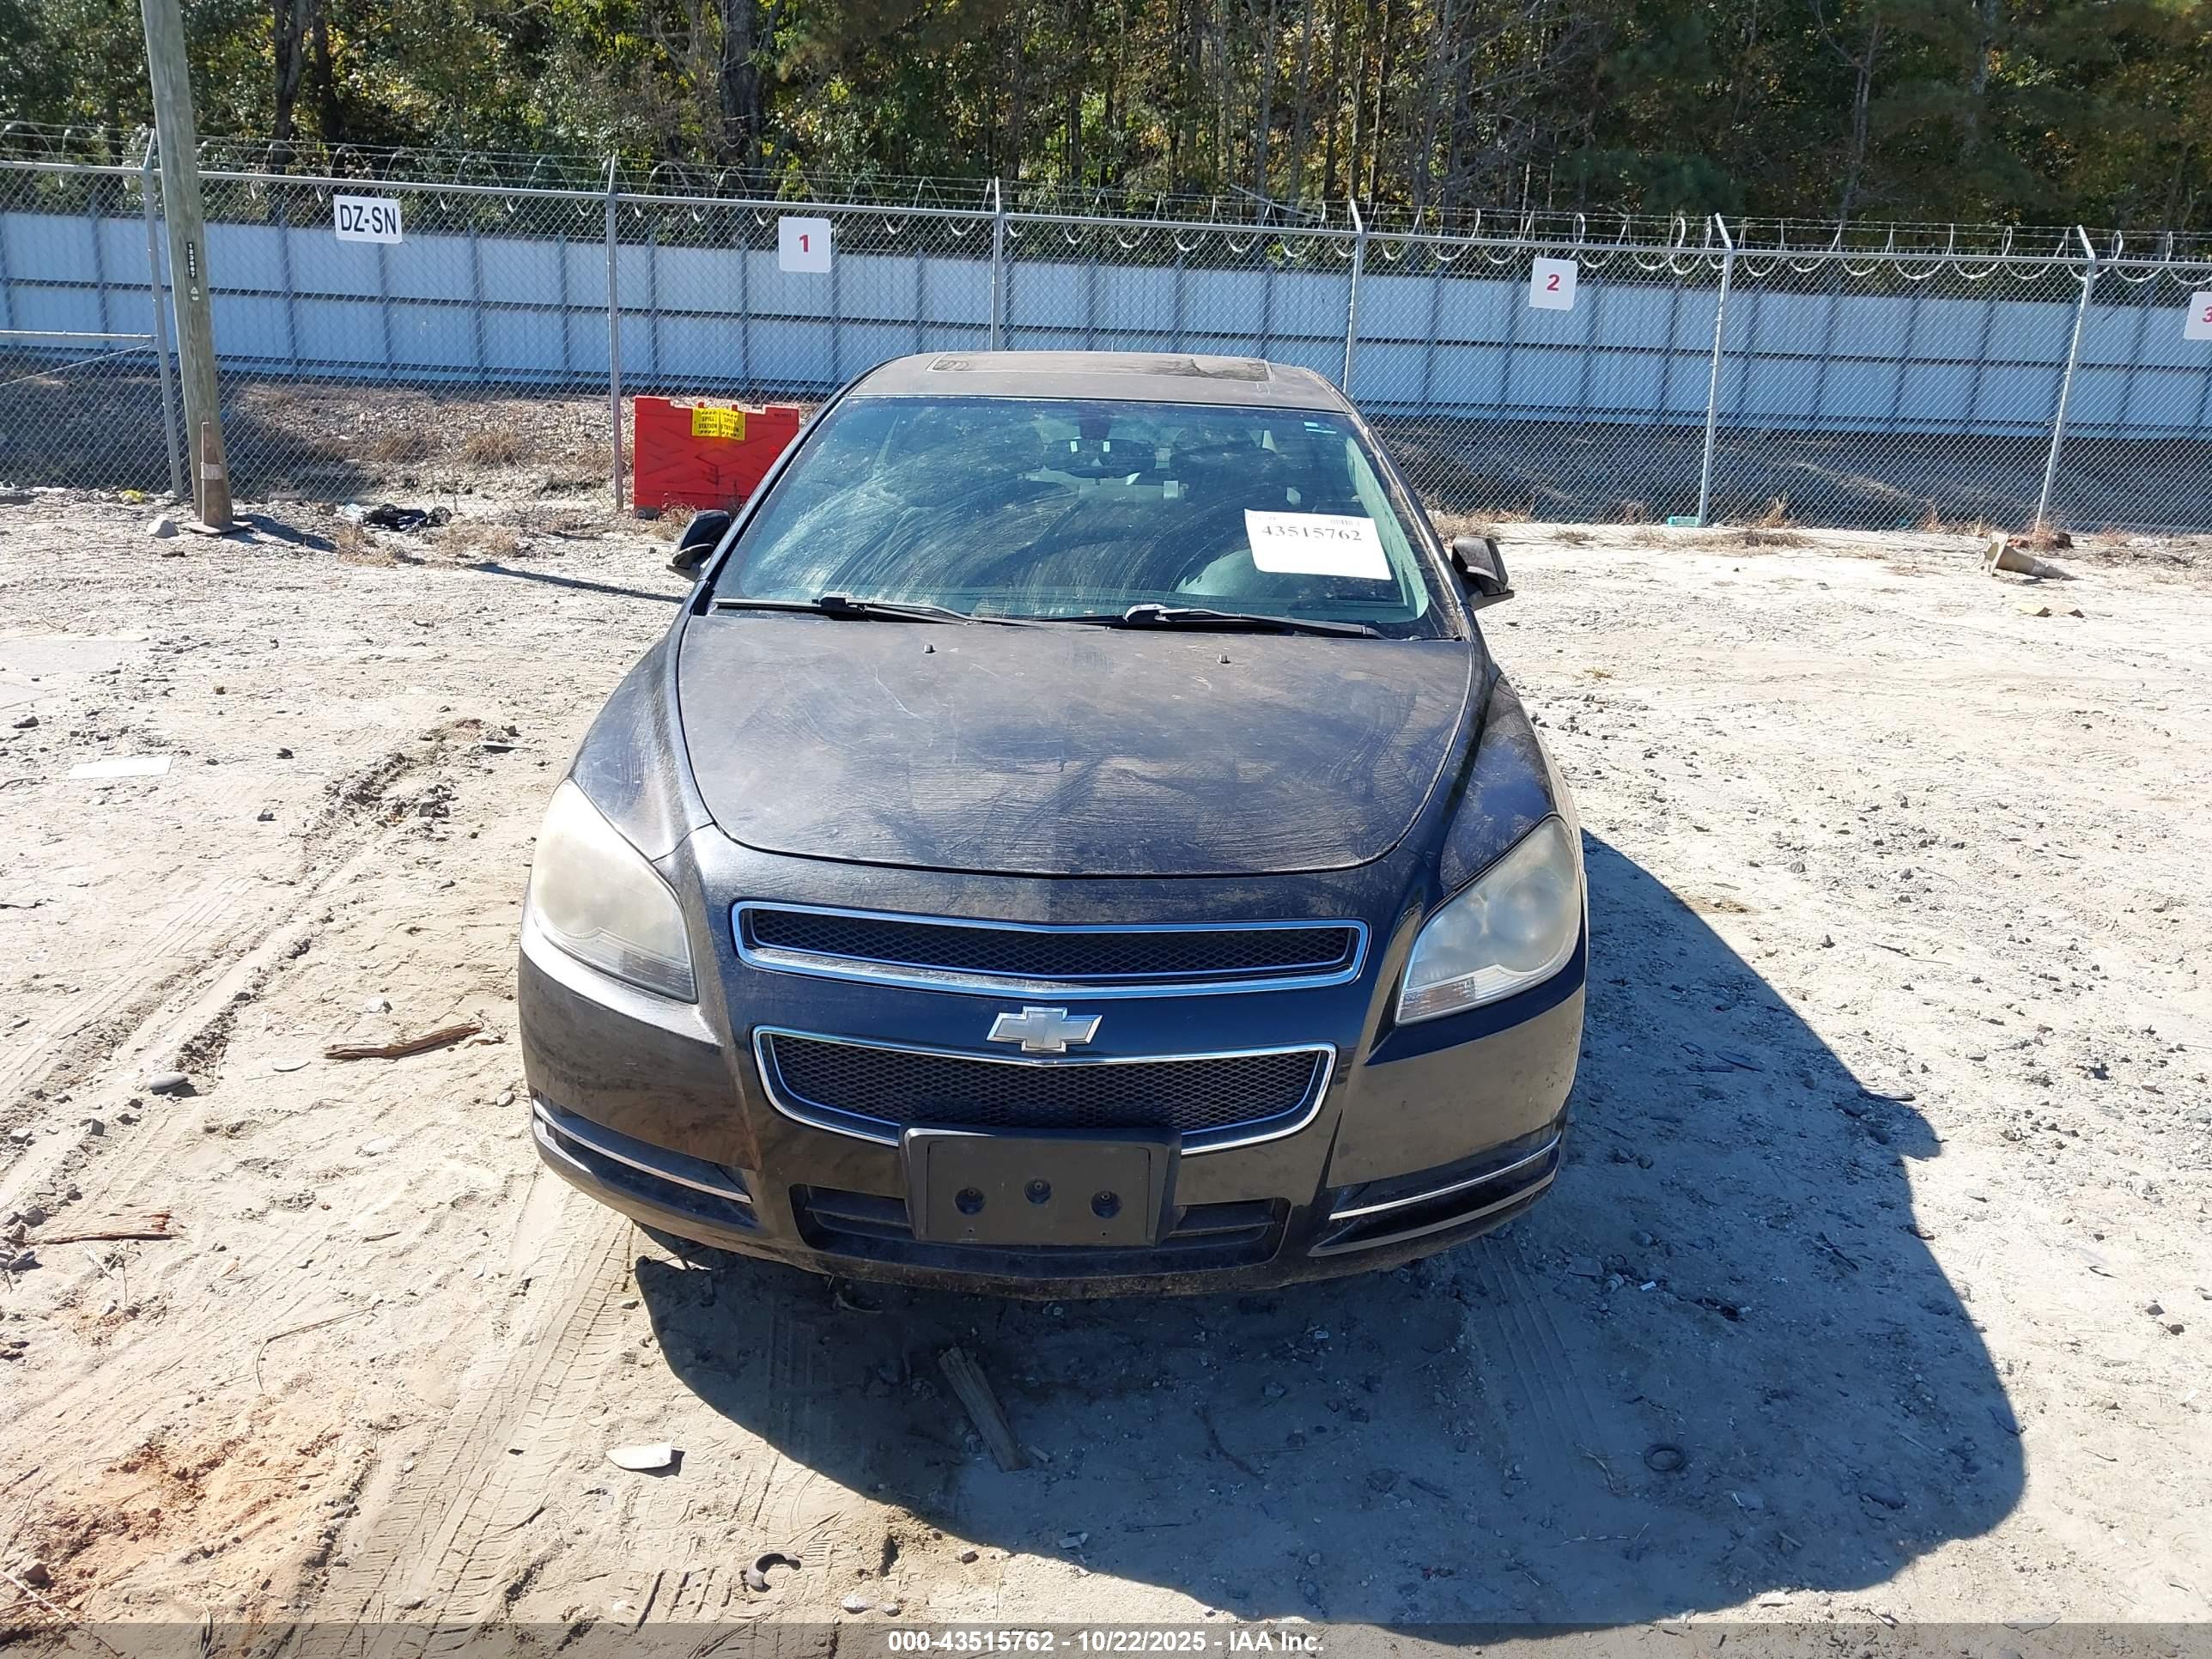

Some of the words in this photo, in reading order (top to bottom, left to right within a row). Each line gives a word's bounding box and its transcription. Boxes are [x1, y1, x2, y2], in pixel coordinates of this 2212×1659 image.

[339, 204, 397, 235] DZ-SN
[799, 234, 809, 253] 1
[1547, 274, 1560, 291] 2
[2202, 306, 2212, 323] 3
[1261, 525, 1363, 542] 43515762
